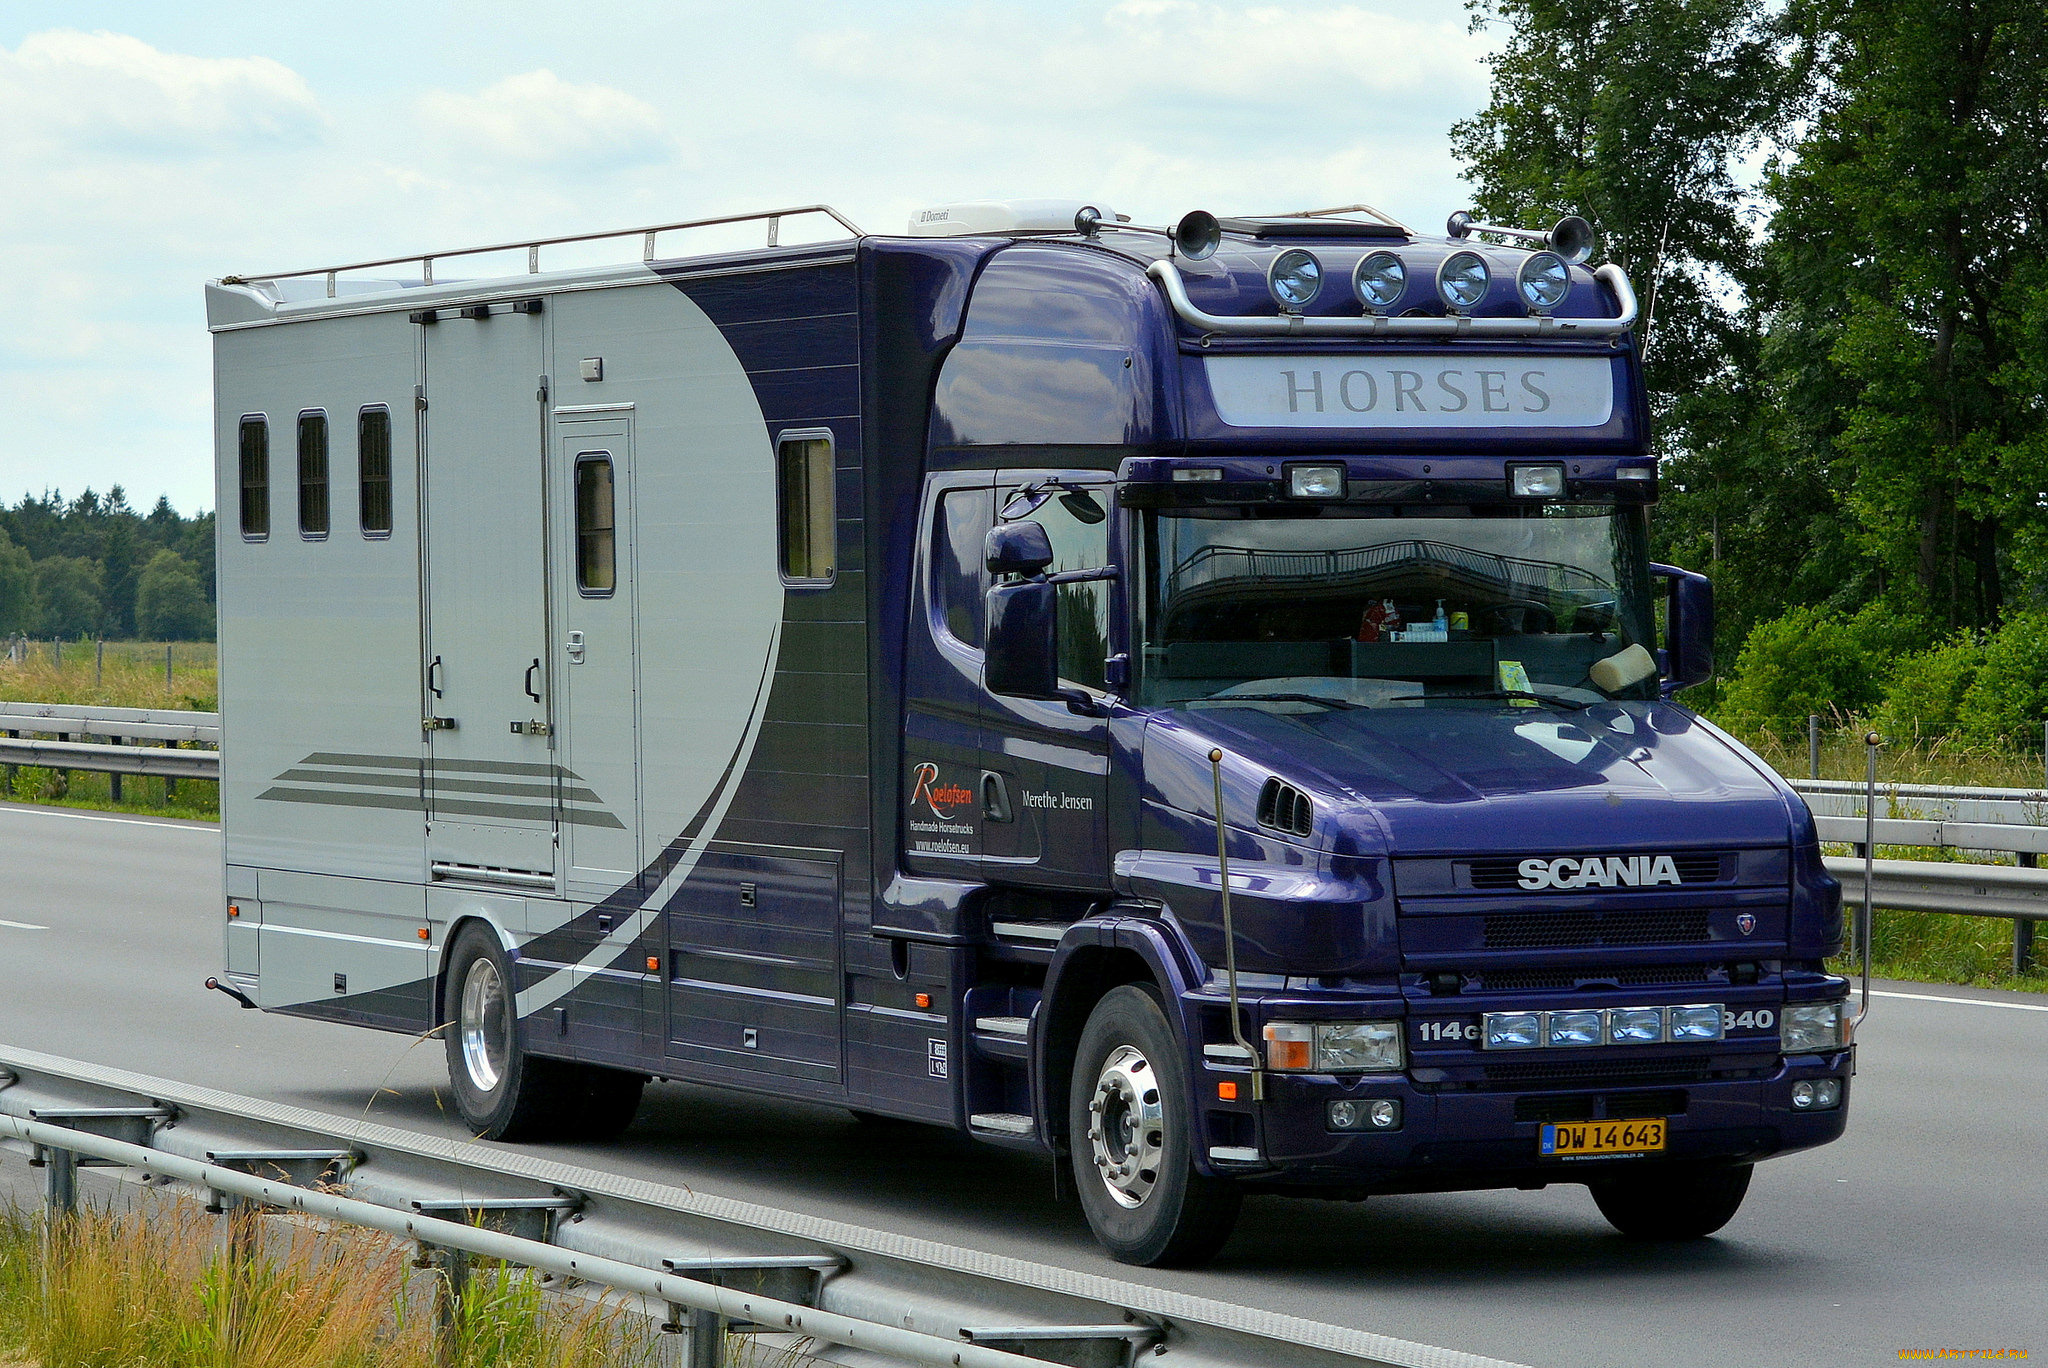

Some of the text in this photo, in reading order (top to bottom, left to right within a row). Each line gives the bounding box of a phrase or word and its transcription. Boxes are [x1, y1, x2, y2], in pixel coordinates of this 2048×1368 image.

[1280, 369, 1552, 413] HORSES
[910, 762, 973, 820] Roelofsen
[1022, 789, 1093, 811] Merethe Jensen
[909, 820, 974, 835] Handmade Horsetrucks
[915, 838, 970, 854] www.roelofsen.eu
[1517, 855, 1682, 890] SCANIA
[1542, 1142, 1553, 1150] DK
[1556, 1124, 1662, 1150] DW 14 643
